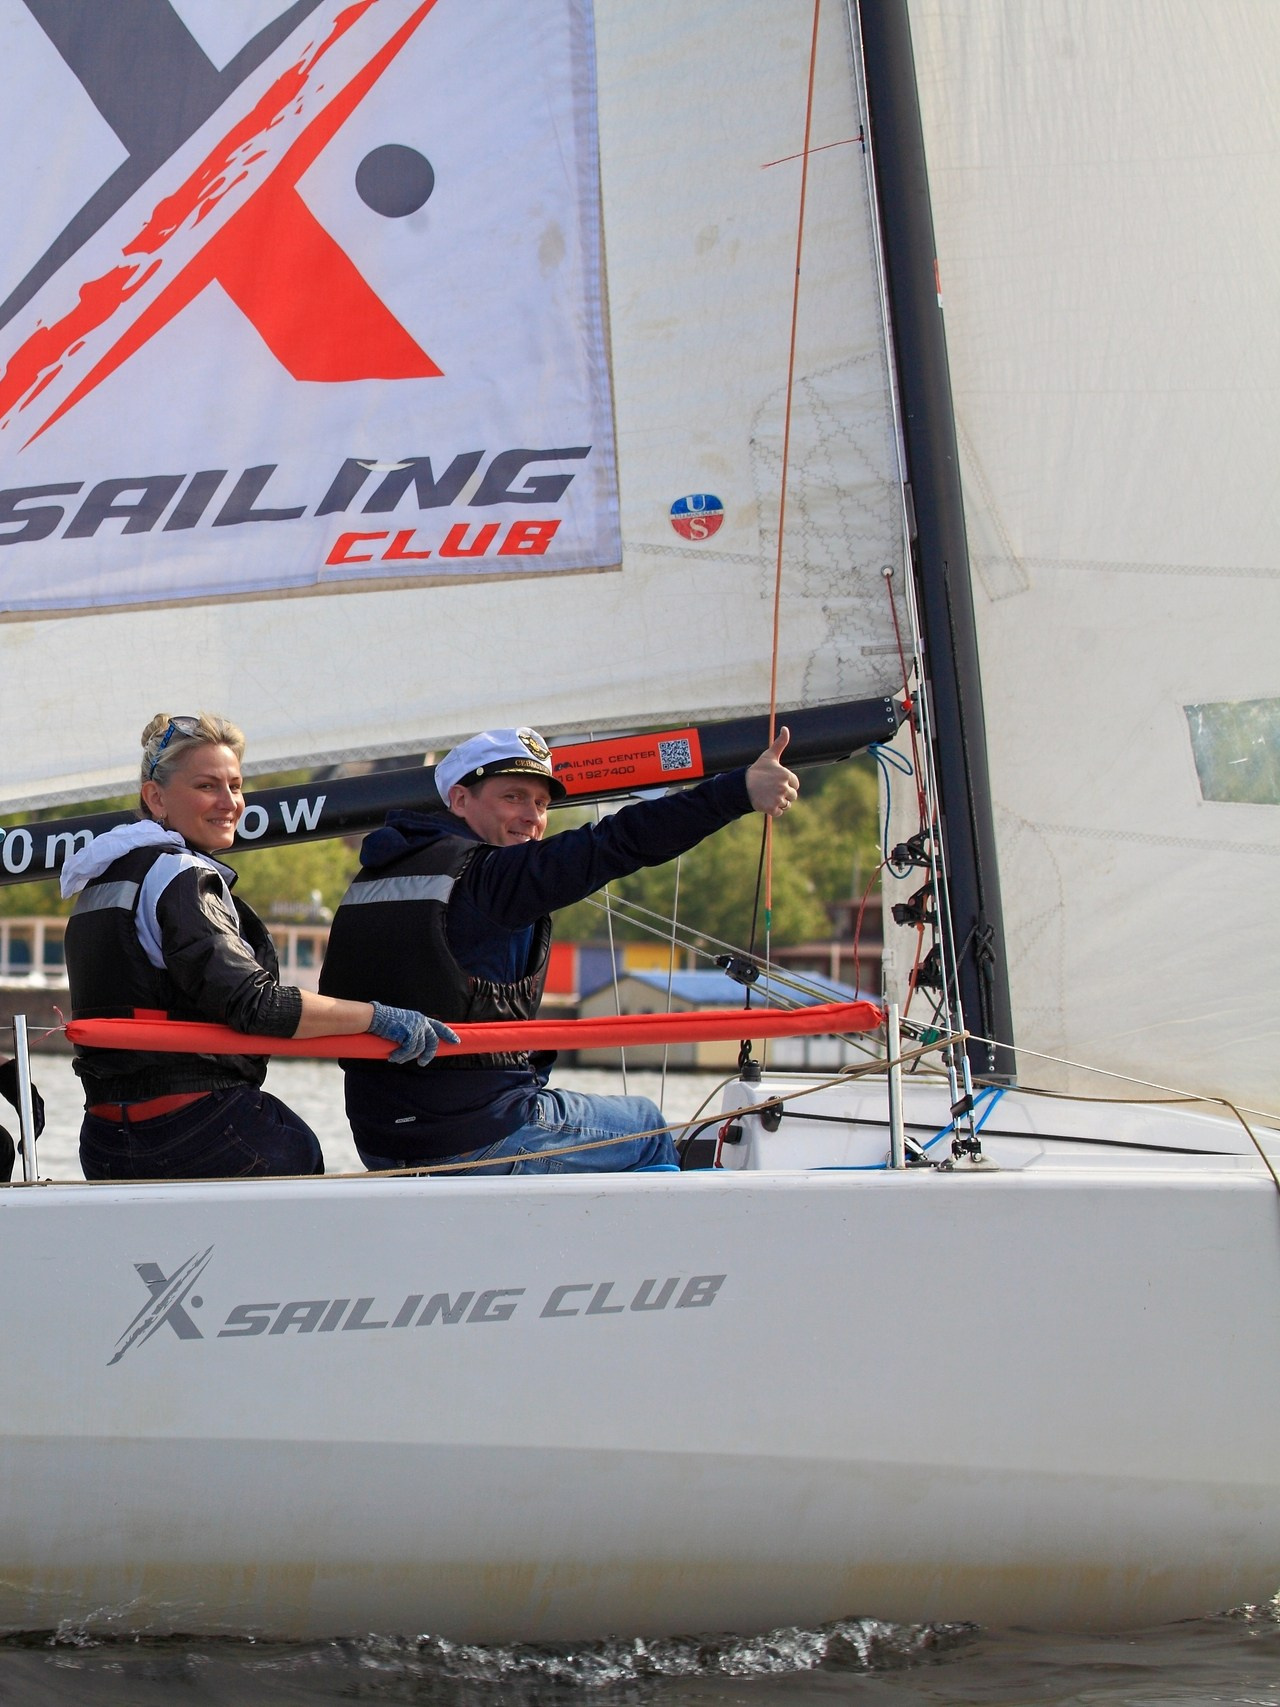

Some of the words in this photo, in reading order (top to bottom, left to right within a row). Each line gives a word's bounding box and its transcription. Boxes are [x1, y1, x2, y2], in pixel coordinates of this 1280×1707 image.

[325, 519, 562, 566] CLUB
[608, 750, 656, 764] CENTER
[577, 765, 635, 781] 1927400
[217, 1288, 526, 1338] SAILING
[539, 1274, 728, 1319] CLUB
